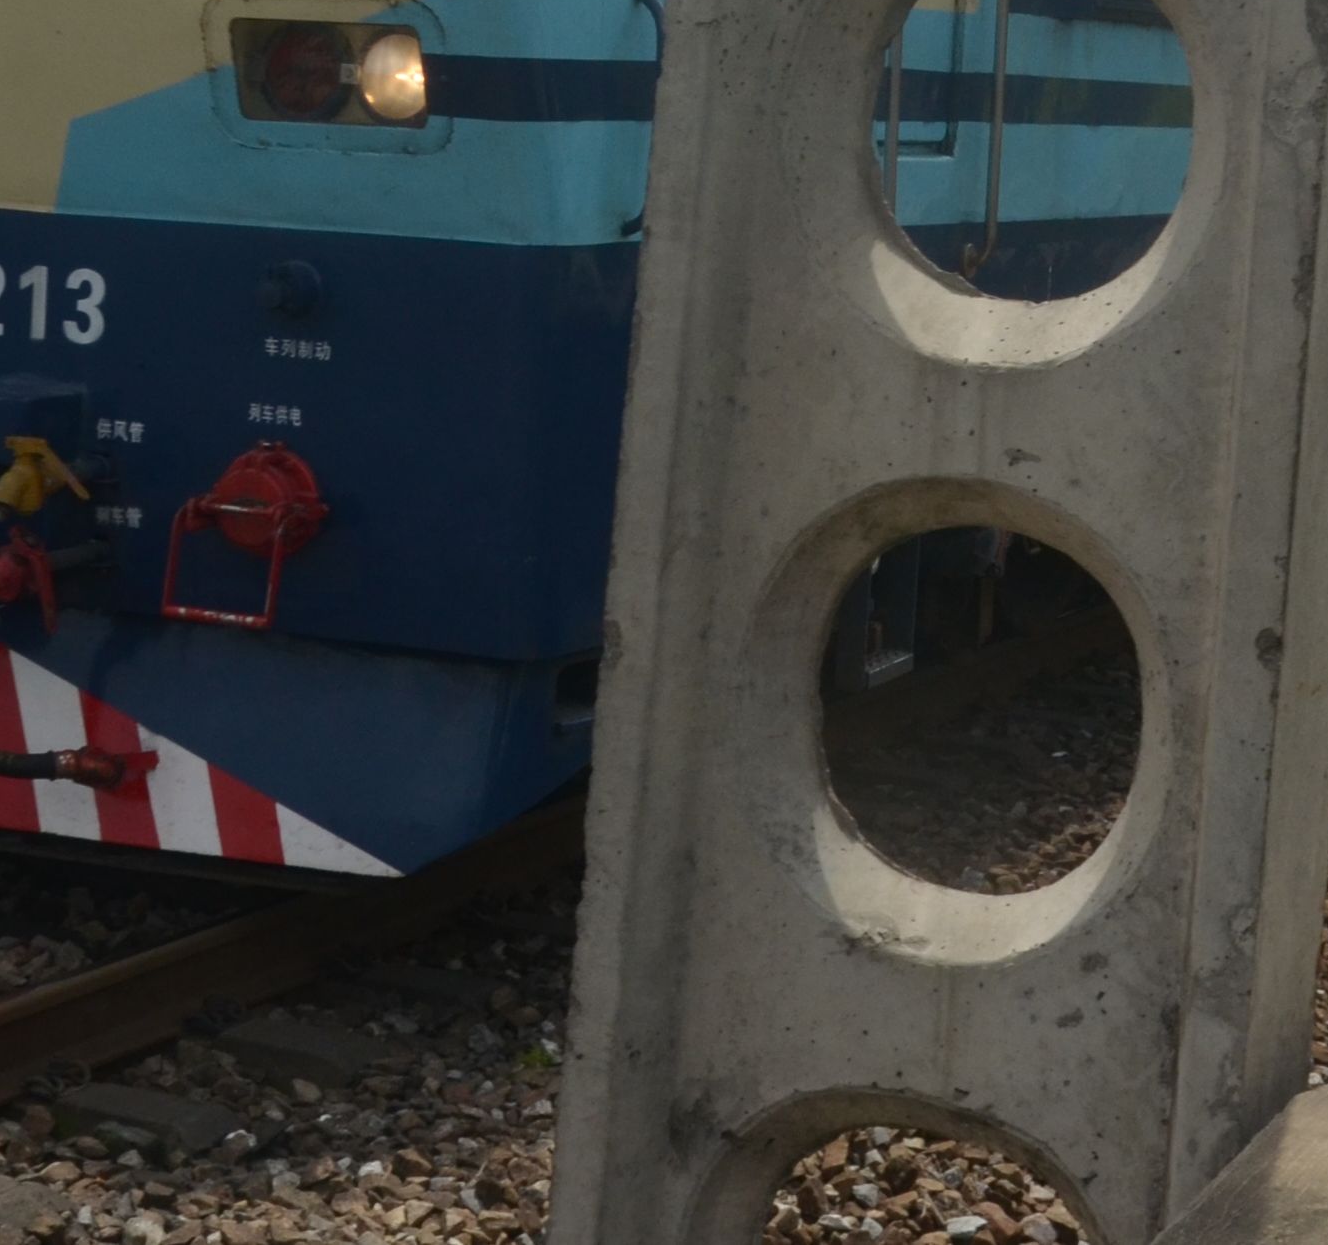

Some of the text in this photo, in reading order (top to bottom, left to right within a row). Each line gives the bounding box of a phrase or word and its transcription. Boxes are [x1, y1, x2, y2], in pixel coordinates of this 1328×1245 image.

[264, 336, 332, 361] 车列制动
[248, 402, 302, 426] 列车供电
